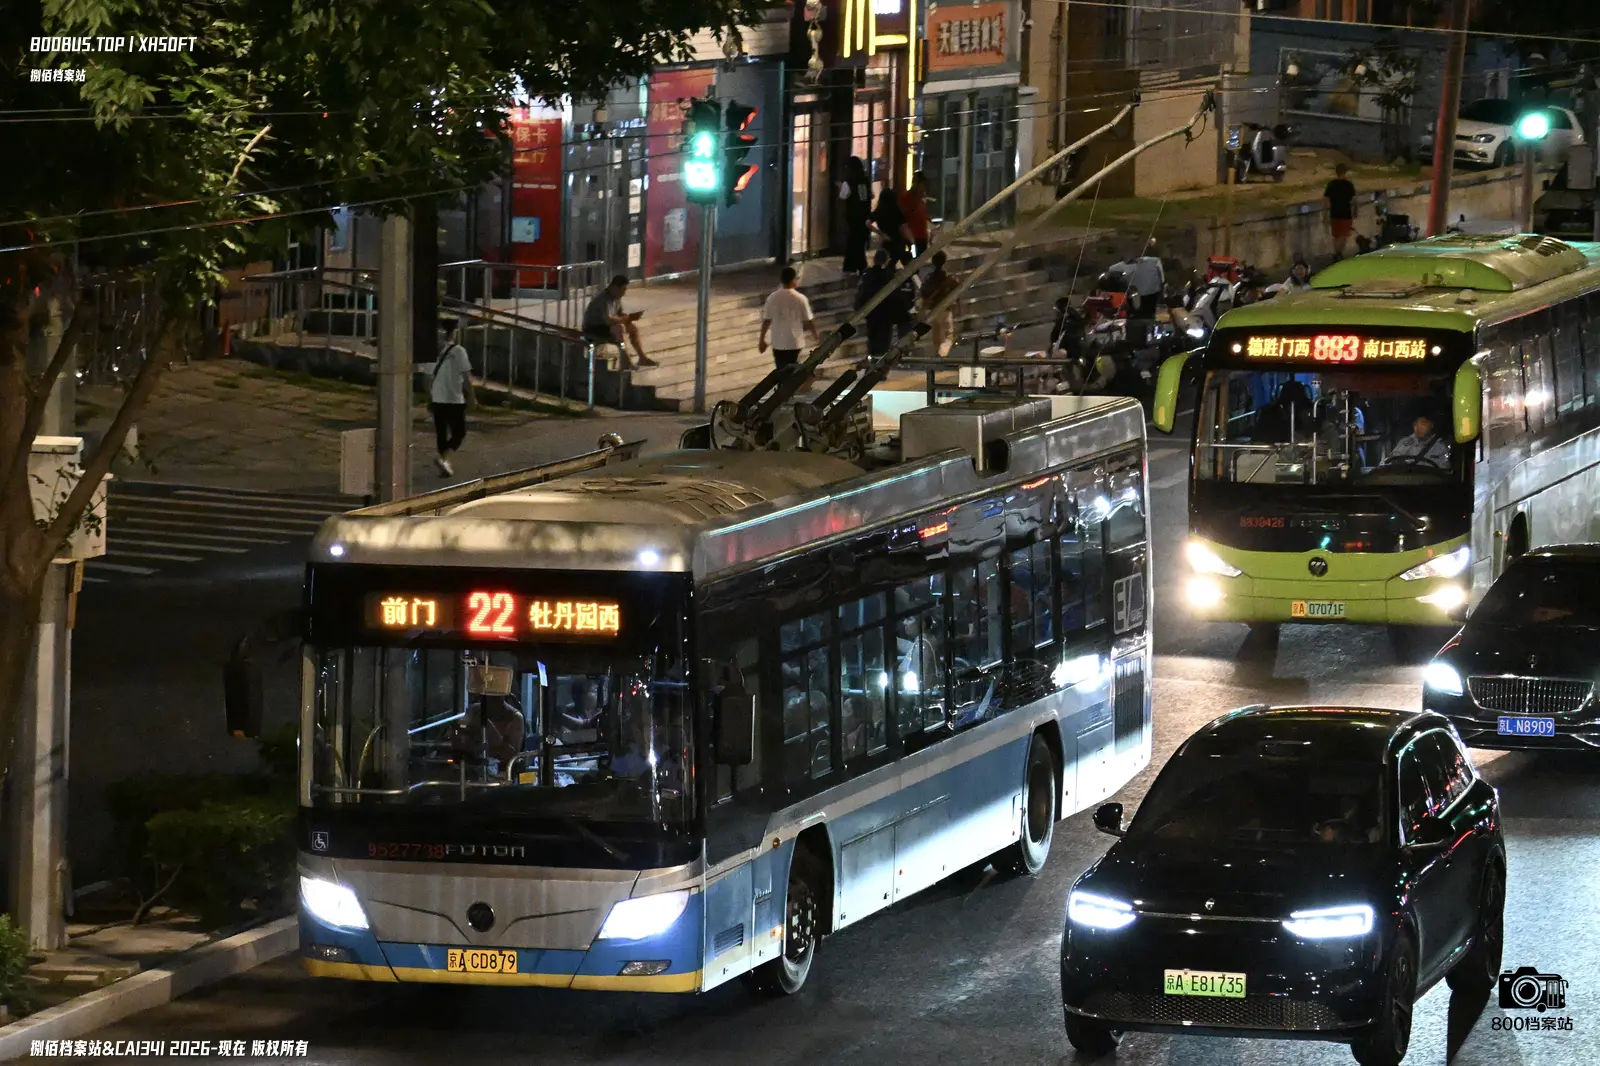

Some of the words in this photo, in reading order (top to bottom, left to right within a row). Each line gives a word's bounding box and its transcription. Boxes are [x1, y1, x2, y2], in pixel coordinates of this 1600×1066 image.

[1247, 337, 1311, 357] 德胜门西
[1313, 335, 1360, 361] 883
[1363, 339, 1427, 359] 南口西站
[380, 597, 436, 626] 前门
[468, 591, 515, 633] 22
[529, 601, 620, 631] 牡丹园西
[367, 842, 445, 859] 9527738
